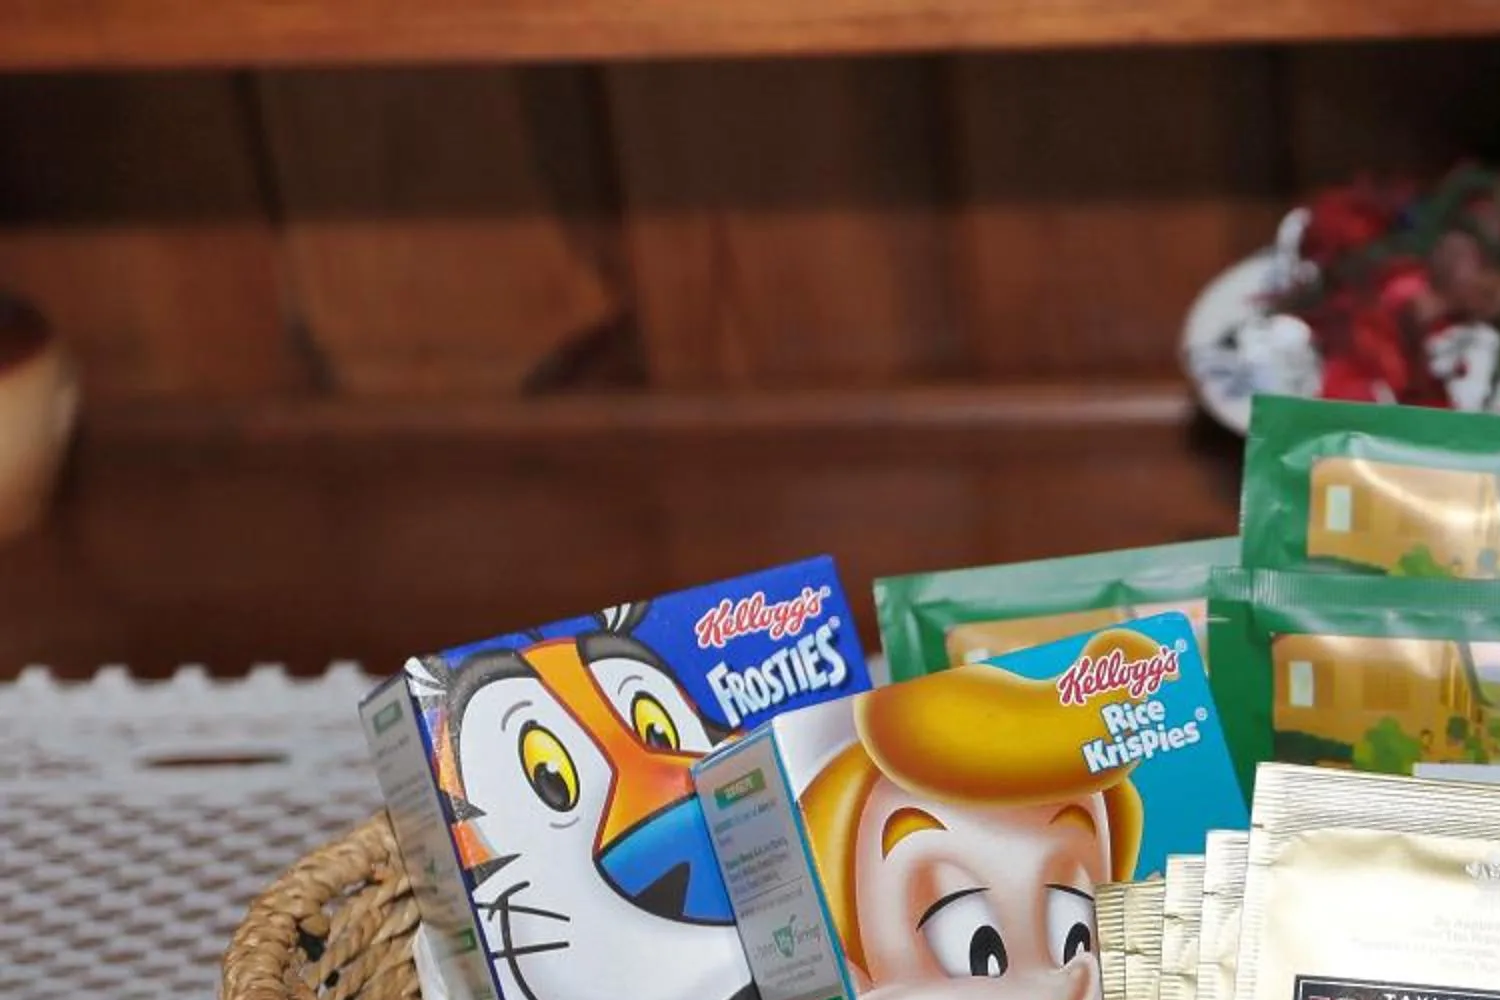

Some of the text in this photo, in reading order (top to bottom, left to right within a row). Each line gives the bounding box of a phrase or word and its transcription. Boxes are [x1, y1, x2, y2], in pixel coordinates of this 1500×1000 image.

[696, 588, 823, 648] Kellogg's
[706, 624, 847, 728] FROSTIES
[1059, 646, 1179, 706] Kellogg's
[1082, 721, 1201, 774] Krispies
[1100, 700, 1166, 735] Rice
